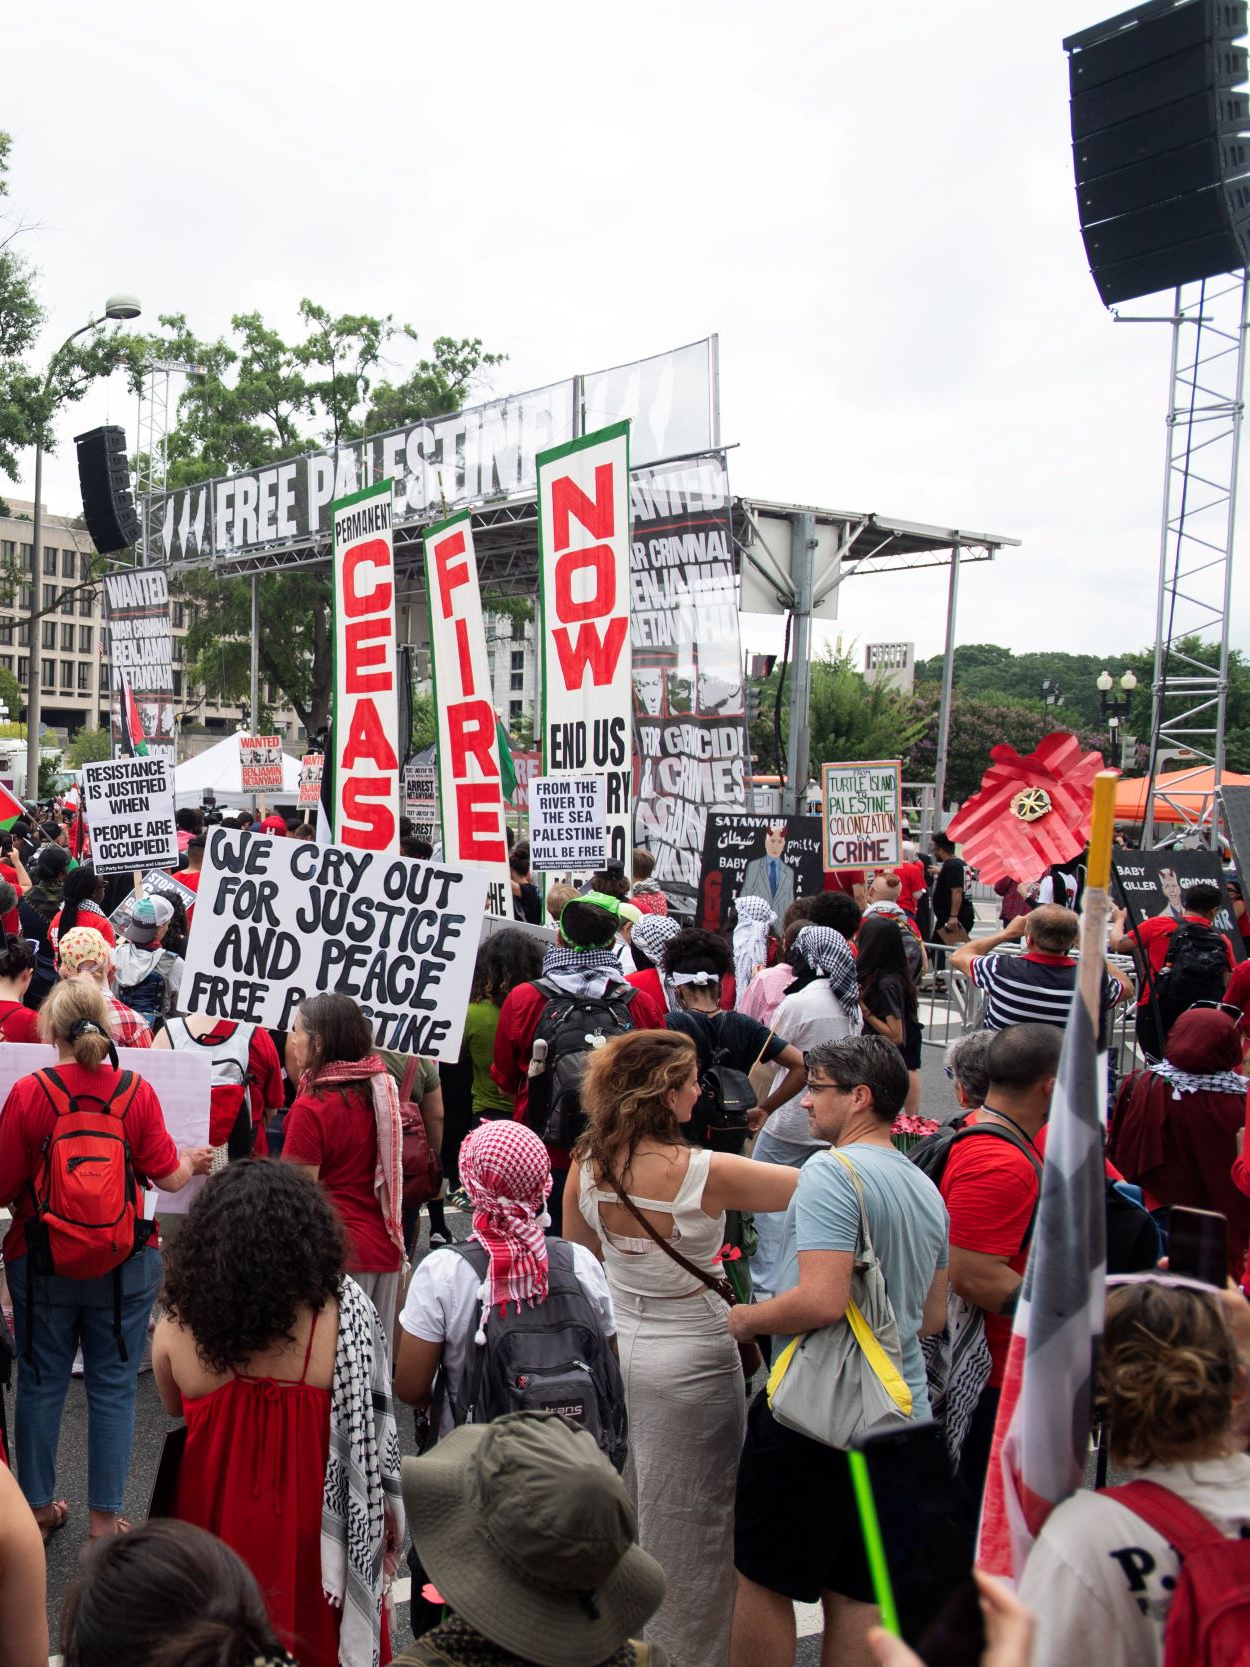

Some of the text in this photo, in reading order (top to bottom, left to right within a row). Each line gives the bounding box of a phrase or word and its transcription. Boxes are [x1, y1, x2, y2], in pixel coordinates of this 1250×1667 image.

[216, 388, 566, 551] FREE PALESTINE
[334, 502, 392, 547] PERMANENT
[551, 462, 628, 692] NOW
[630, 560, 737, 611] ENJAMIN
[105, 570, 168, 609] WANTED
[110, 620, 133, 640] WAR
[112, 637, 172, 666] BENJAMIN
[433, 531, 507, 863] FIRE
[240, 736, 279, 748] WANTED
[550, 716, 626, 770] END US
[640, 726, 662, 757] FOR
[86, 760, 166, 783] RESISTANCE
[242, 767, 282, 777] BENJAMIN
[242, 776, 282, 786] NETANYAHU
[640, 757, 745, 802] & CRIMES
[89, 777, 167, 800] IS JUSTIFIED
[406, 780, 434, 792] ARREST
[536, 781, 598, 795] FROM THE
[829, 775, 896, 792] TURTLE ISLAND
[109, 797, 150, 814] WHEN
[406, 792, 435, 800] NETANYAHU
[540, 796, 594, 809] RIVER TO
[829, 796, 894, 815] PALESTINE
[542, 811, 593, 824] THE SEA
[715, 816, 788, 828] SATANYAHU
[829, 813, 897, 836] COLONIZATION
[92, 819, 173, 842] PEOPLE ARE
[532, 826, 603, 842] PALESTINE
[717, 830, 755, 850] شيطان
[99, 837, 170, 859] OCCUPIED!
[532, 845, 605, 858] WILL BE FREE
[832, 839, 889, 864] CRIME
[210, 829, 463, 910] WE CRY OUT
[719, 857, 748, 870] BABY
[784, 853, 802, 867] boy
[1116, 865, 1145, 876] BABY
[148, 872, 175, 890] STOP
[212, 876, 281, 927] FOR
[296, 885, 466, 961] JUSTICE
[214, 924, 447, 1011] AND PEACE
[187, 971, 451, 1056] FREE PSTINE
